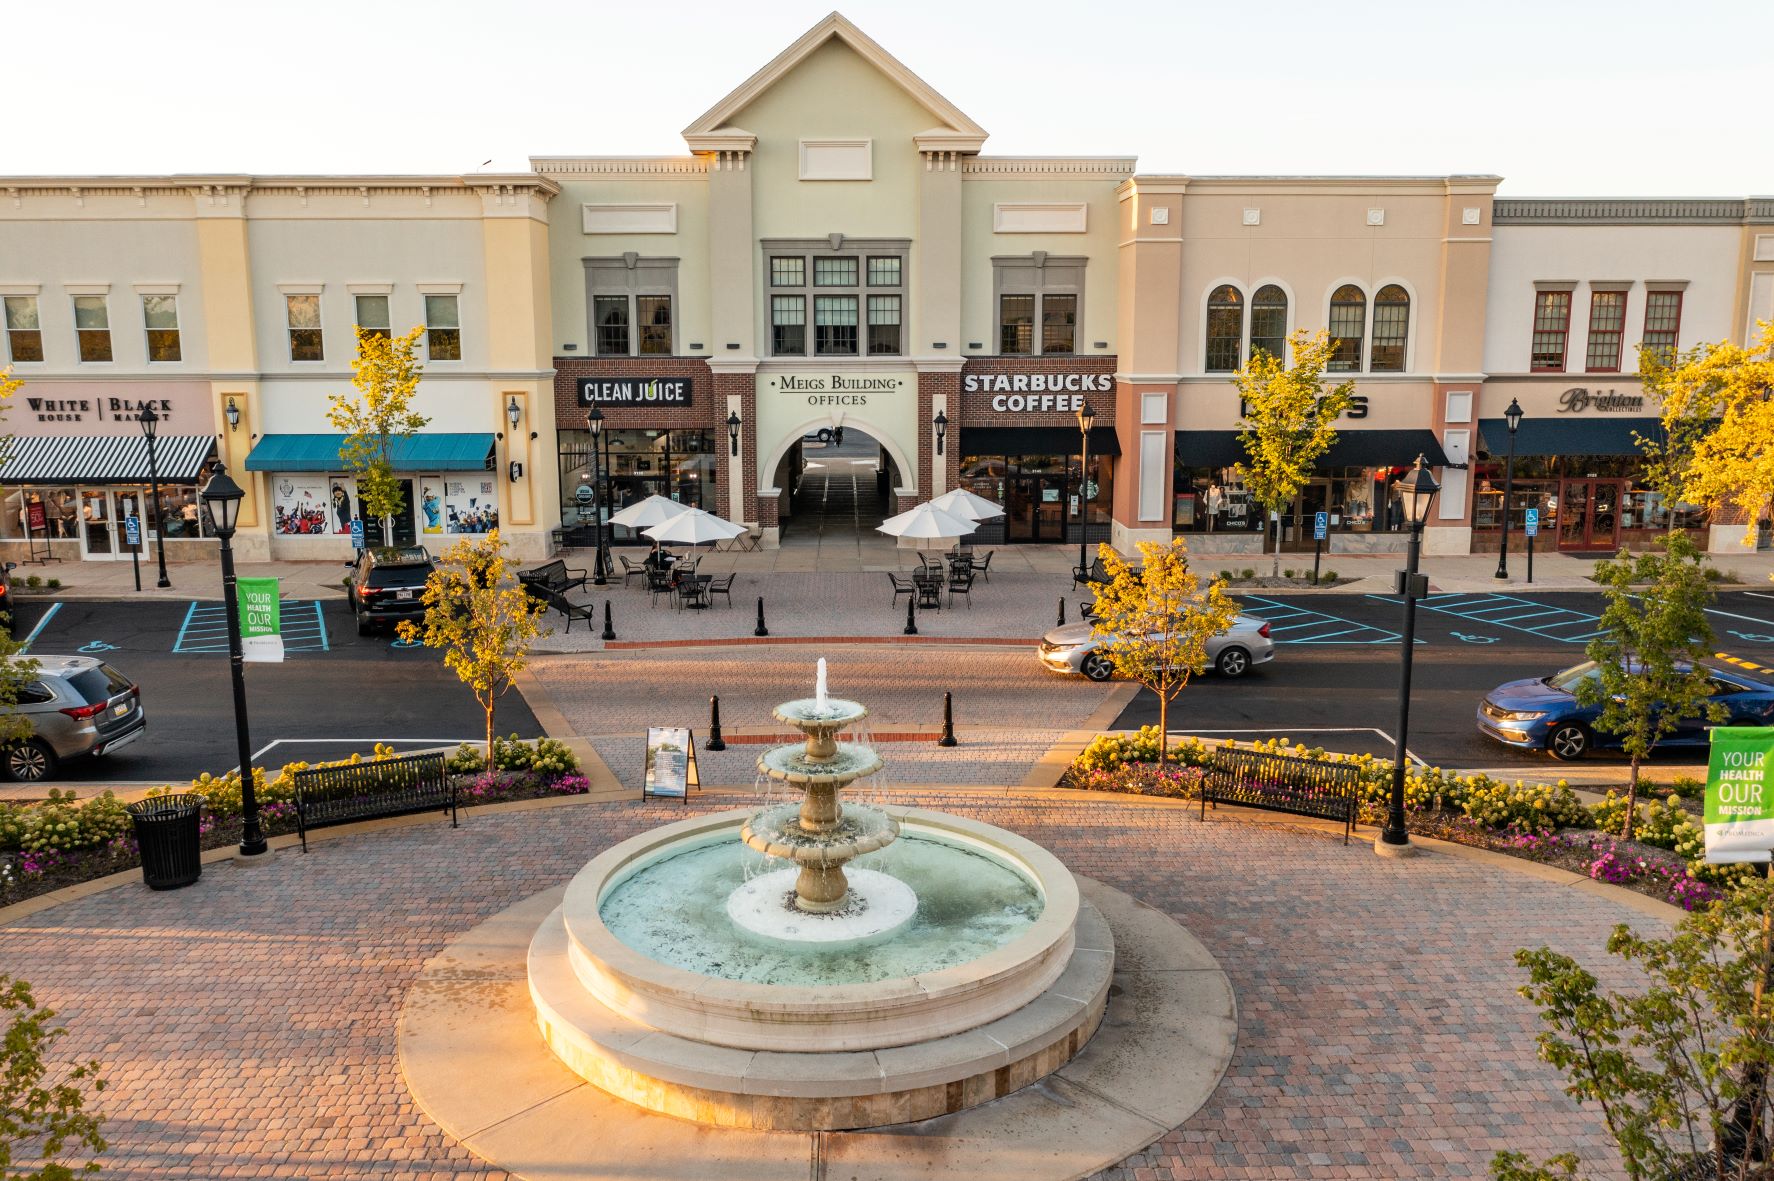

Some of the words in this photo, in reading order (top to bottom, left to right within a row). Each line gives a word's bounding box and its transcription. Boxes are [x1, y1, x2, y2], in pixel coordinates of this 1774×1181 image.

[780, 375, 825, 390] MEIGS
[831, 375, 896, 390] BUILDING
[964, 374, 1112, 392] STARBUCKS
[584, 383, 632, 401] CLEAN
[635, 379, 684, 401] JUICE
[26, 398, 90, 412] WHITE
[109, 398, 172, 411] BLACK
[808, 395, 867, 406] OFFICES
[992, 395, 1084, 412] COFFEE
[1556, 388, 1644, 413] Brighton
[38, 414, 82, 422] HOUSE
[245, 592, 271, 604] YOUR
[248, 612, 272, 625] OUR
[1722, 752, 1765, 767] YOUR
[1720, 769, 1764, 781] HEALTH
[1718, 783, 1763, 803] OUR
[1718, 805, 1762, 816] MISSION
